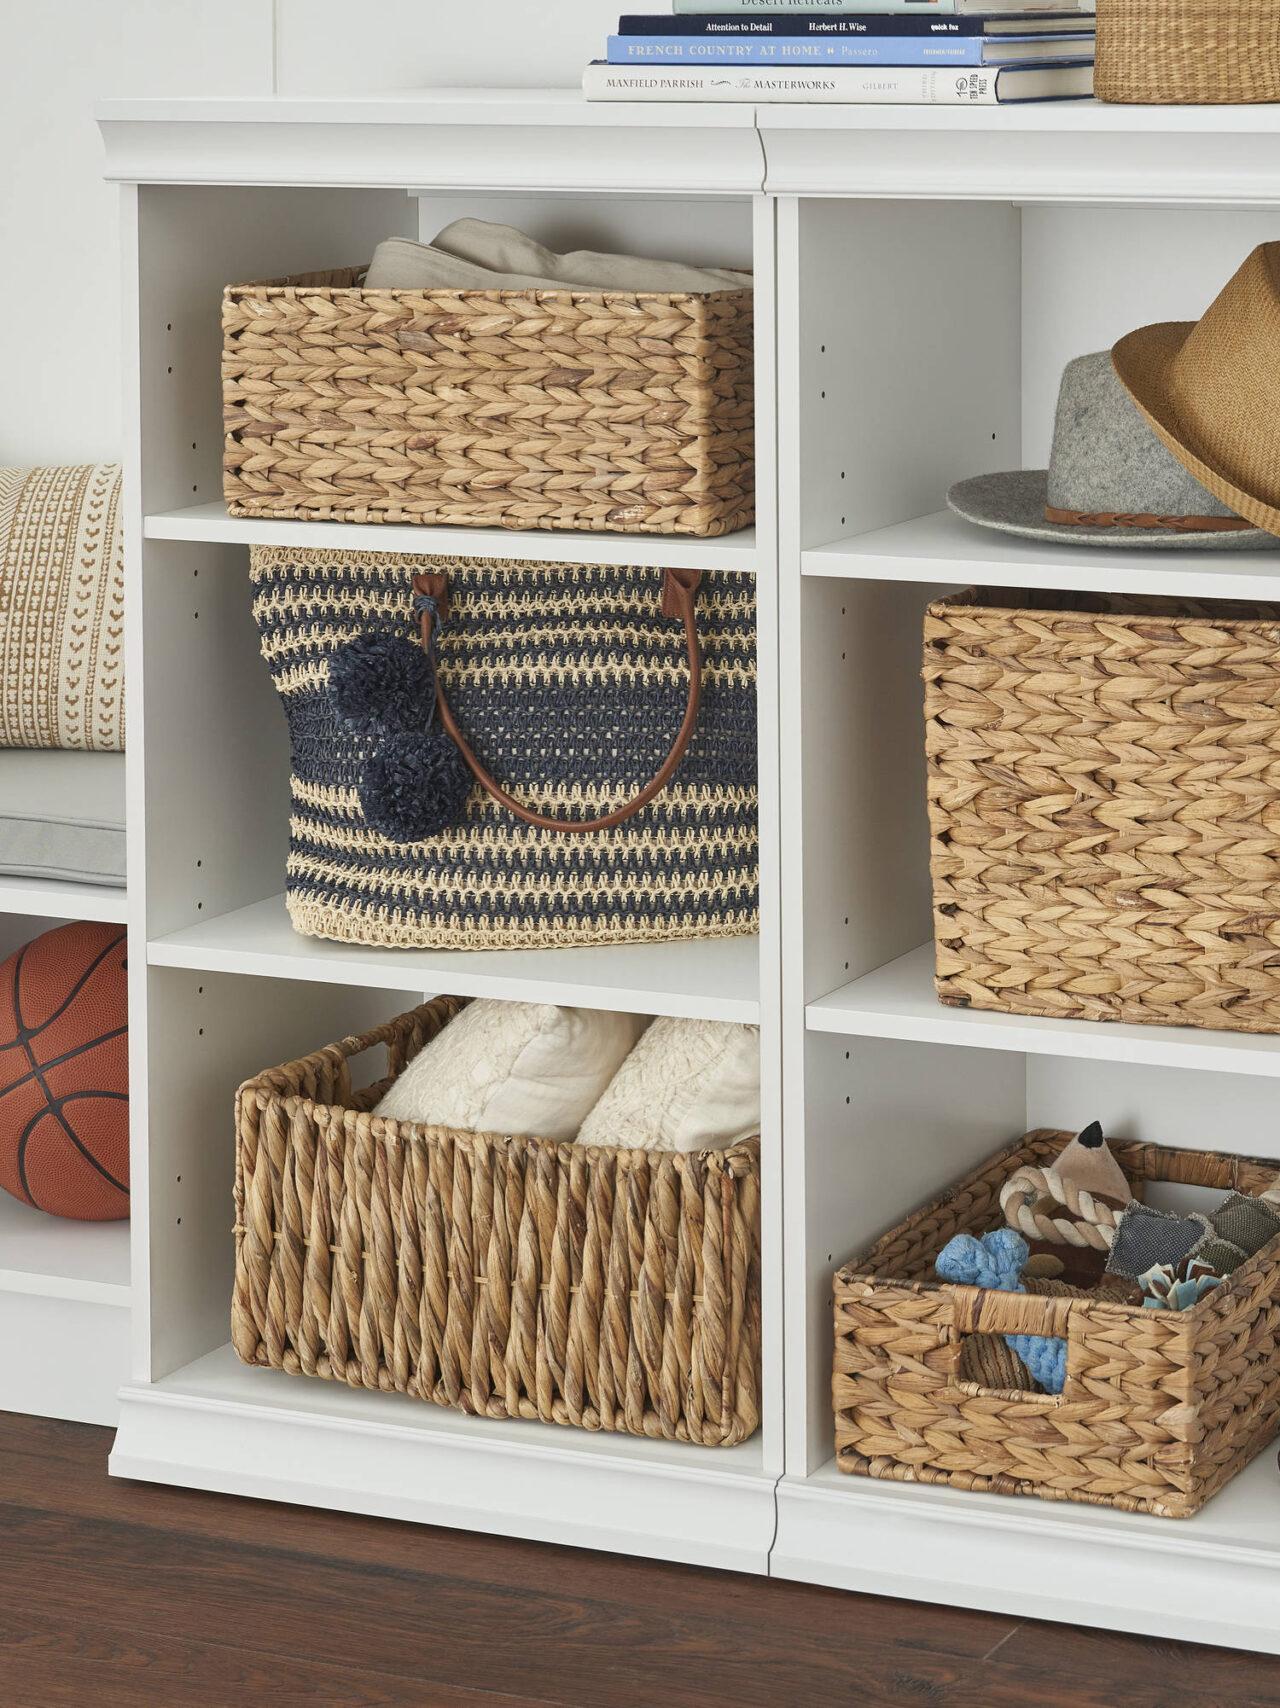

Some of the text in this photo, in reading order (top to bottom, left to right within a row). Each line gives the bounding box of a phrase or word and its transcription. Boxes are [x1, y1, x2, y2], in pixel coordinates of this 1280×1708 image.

[706, 23, 772, 31] Attention to Detail
[808, 22, 867, 32] Herbert H. Wise
[628, 45, 822, 56] FRENCH COUNTRY AT HOME
[606, 79, 704, 89] MAXFIELD PARRISH
[753, 80, 836, 90] MASTERWORKS
